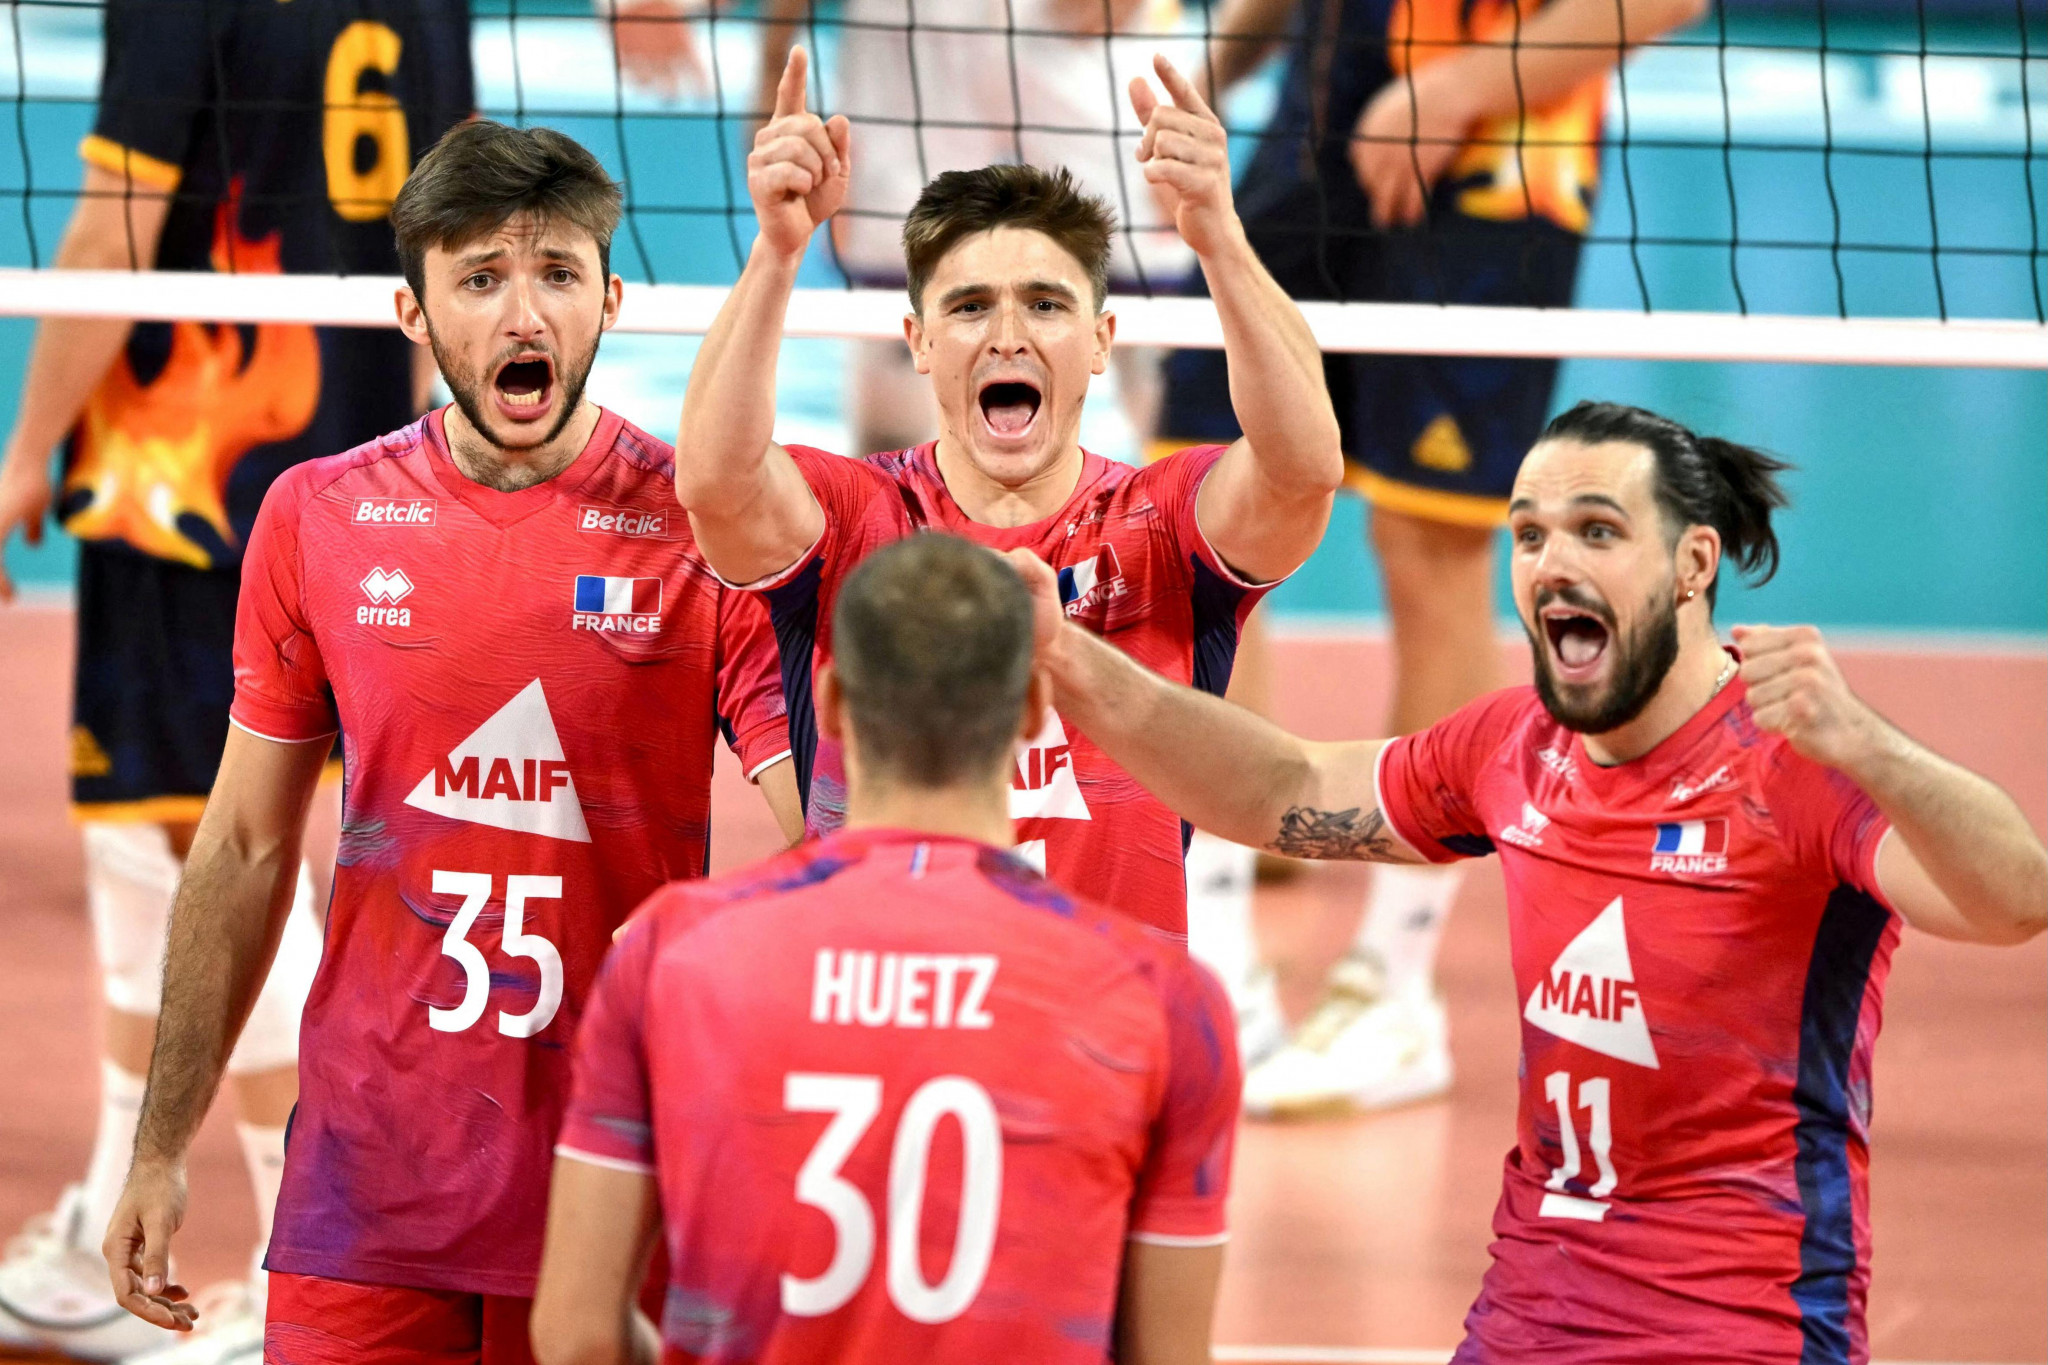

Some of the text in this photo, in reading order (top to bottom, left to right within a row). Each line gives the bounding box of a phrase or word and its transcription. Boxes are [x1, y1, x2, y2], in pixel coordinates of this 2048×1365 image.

[322, 20, 410, 222] 6
[355, 502, 433, 523] Betclic
[581, 509, 663, 534] Betclic
[356, 606, 411, 627] errea
[1064, 578, 1128, 619] RANCE
[572, 614, 661, 633] FRANCE
[434, 757, 570, 802] MAIF
[1650, 855, 1728, 873] FRANCE
[429, 870, 564, 1038] 35
[810, 948, 999, 1029] HUETZ
[1541, 971, 1638, 1023] MAIF
[1544, 1070, 1617, 1198] 11
[779, 1071, 1003, 1325] 30
